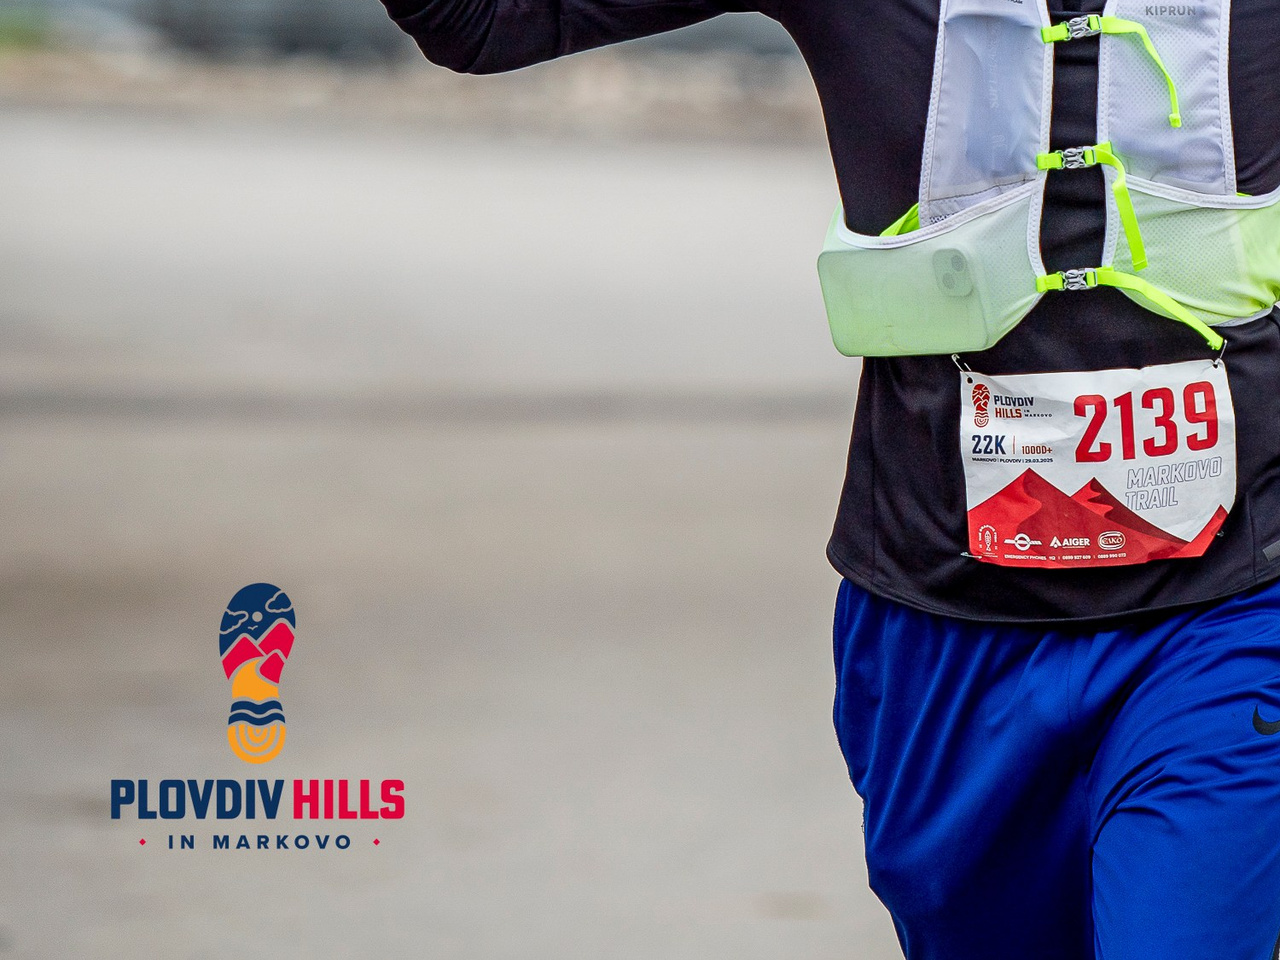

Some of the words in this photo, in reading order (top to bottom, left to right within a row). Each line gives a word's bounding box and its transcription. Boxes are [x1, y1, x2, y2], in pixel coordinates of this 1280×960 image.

[1145, 5, 1197, 16] KIPRUN
[994, 395, 1034, 407] PLOVDIV
[995, 407, 1022, 419] HILLS
[1073, 380, 1219, 463] 2139
[971, 434, 1006, 455] 22K
[1021, 445, 1053, 455] 1000D+
[1127, 456, 1223, 489] MARKOVO
[1125, 486, 1179, 511] TRAIL
[1062, 538, 1090, 546] AIGER
